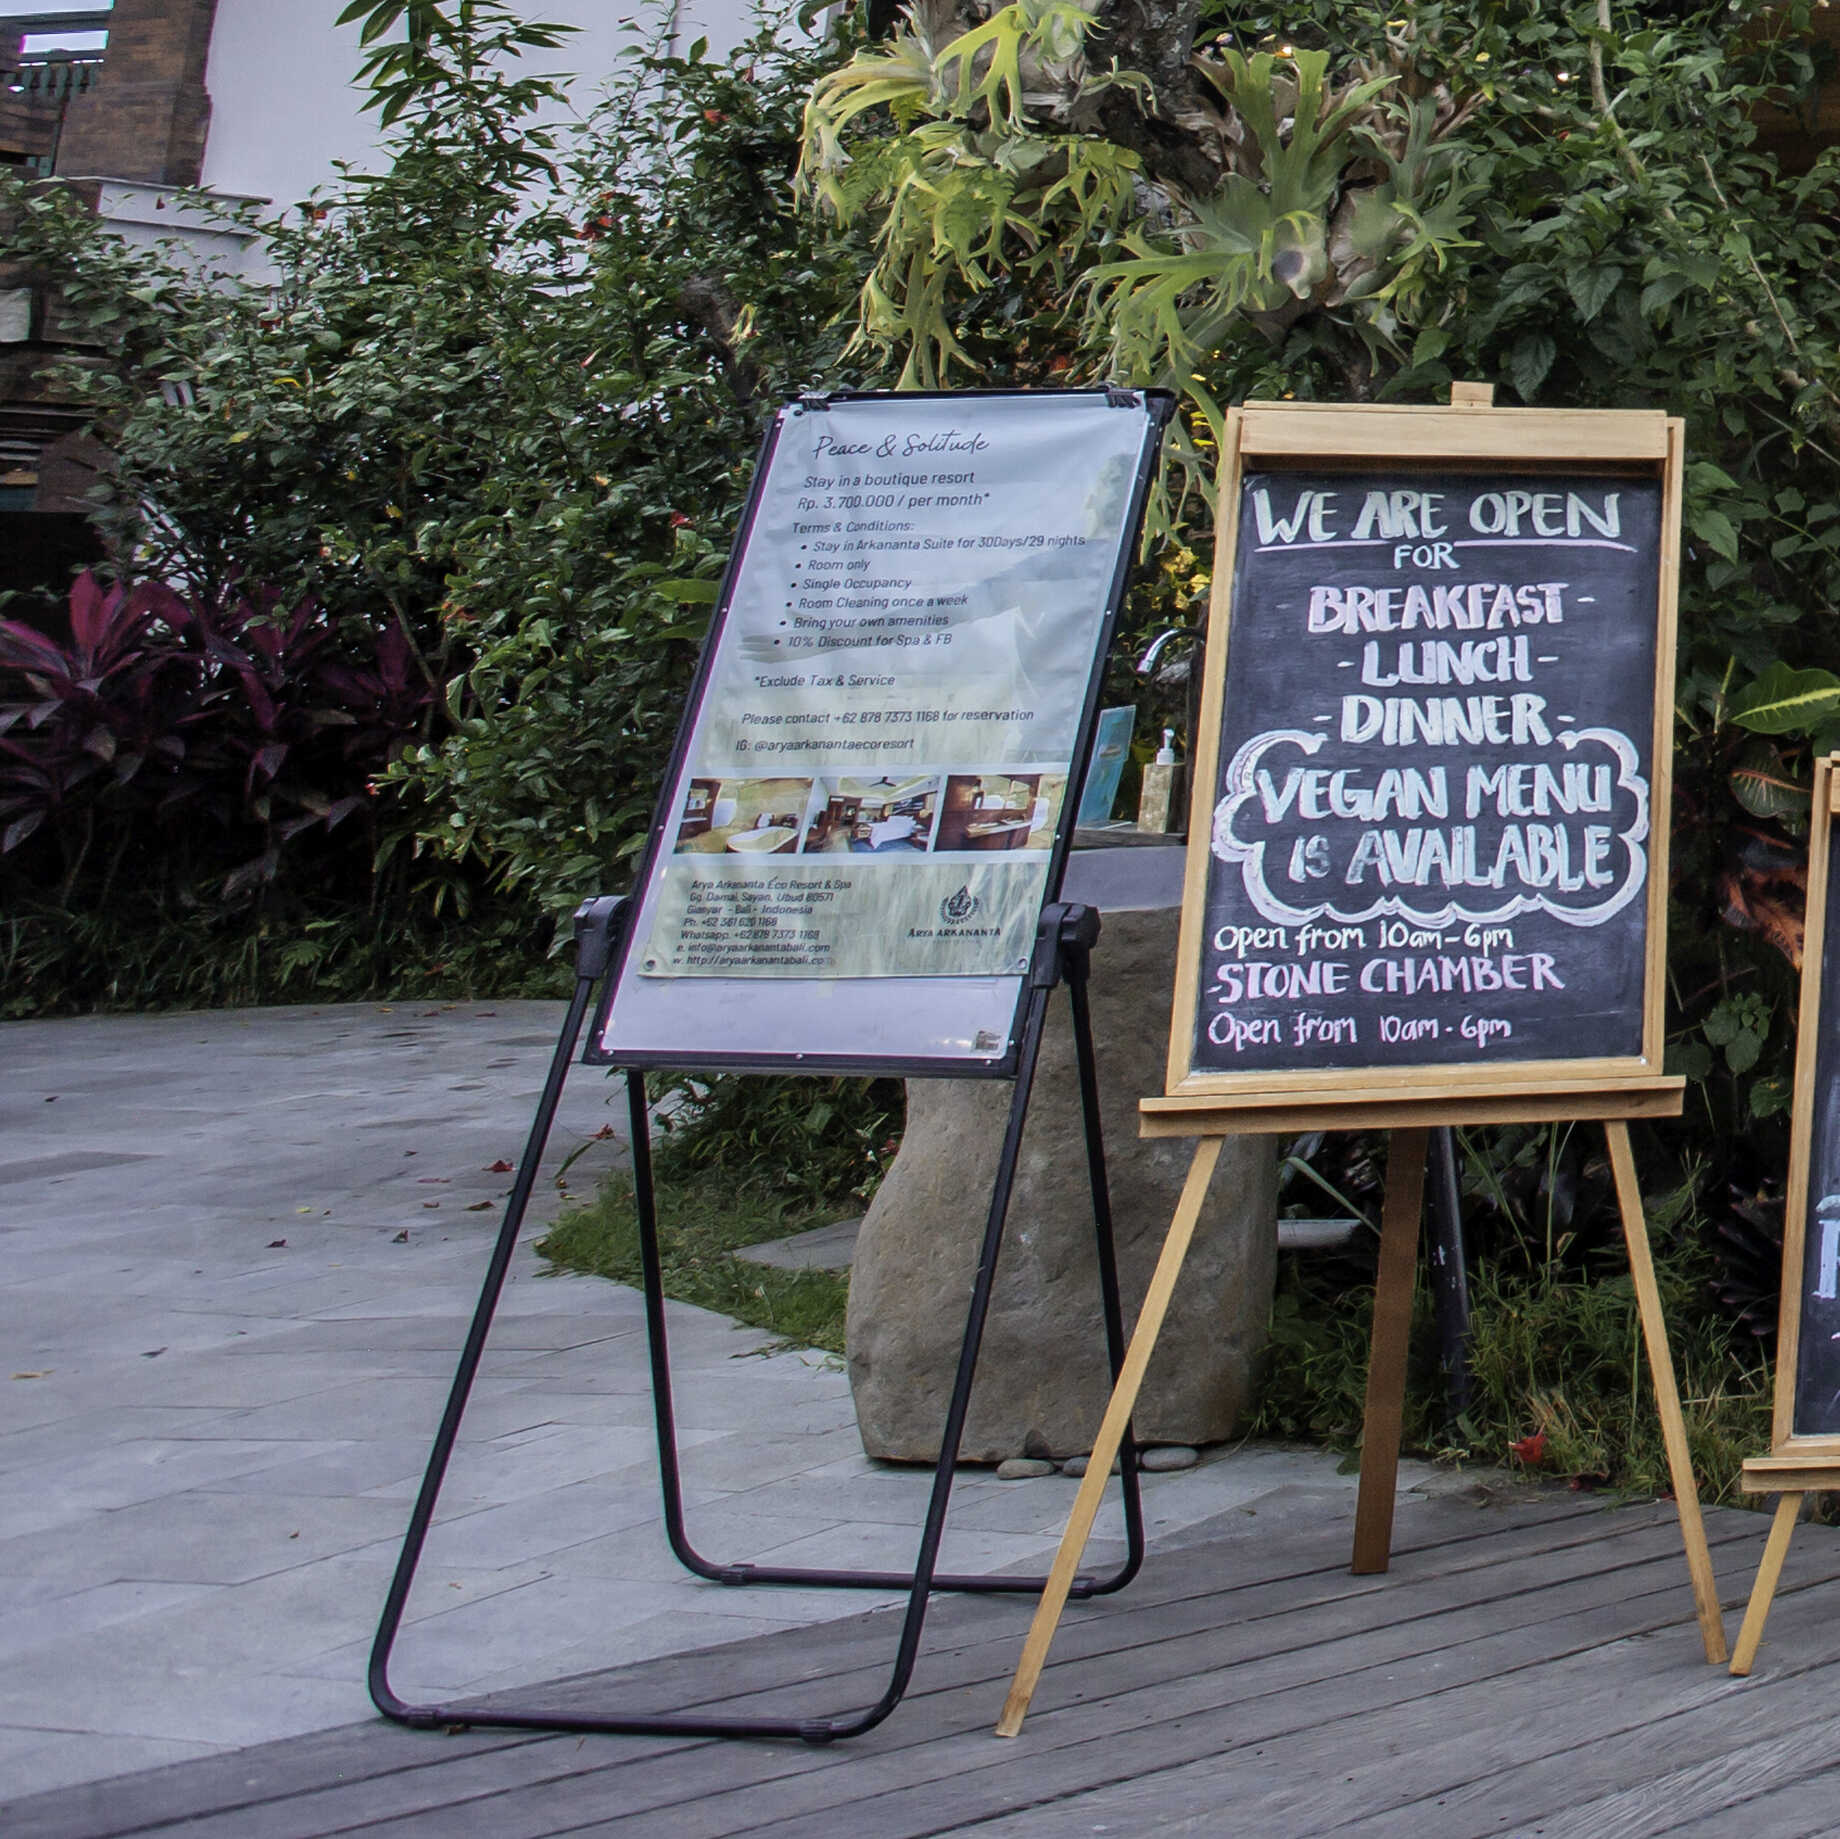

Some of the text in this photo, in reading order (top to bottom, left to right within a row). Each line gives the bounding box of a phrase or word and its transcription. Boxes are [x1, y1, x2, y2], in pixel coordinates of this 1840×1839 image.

[813, 429, 990, 459] Peace & Solitude
[804, 471, 975, 490] Stay in a boutique resort
[797, 496, 819, 512] Rp.
[823, 494, 894, 510] 3.700.000
[897, 495, 905, 508] /
[908, 496, 933, 510] per
[1252, 489, 1620, 545] WE ARE OPEN
[792, 520, 916, 535] Terms & Conditions:
[813, 541, 839, 554] Stay
[843, 540, 854, 552] in
[856, 538, 921, 551] Arkananta
[923, 538, 954, 550] Suite
[957, 537, 975, 549] for
[1047, 534, 1086, 548] nights
[1393, 543, 1460, 569] FOR
[808, 559, 871, 573] Room only
[802, 578, 912, 592] Single Occupancy
[798, 594, 968, 610] Room Cleaning once a week
[1308, 582, 1569, 634] BREAKFAST
[794, 614, 949, 631] Bring your own amenities
[787, 633, 952, 648] 10% Discount for Spa & FB
[1361, 635, 1533, 687] LUNCH
[810, 674, 833, 687] Tax
[835, 674, 845, 686] &
[848, 674, 896, 686] Service
[741, 709, 1034, 725] Please contact +62 878 7373 1168 for reservation
[1341, 693, 1556, 746] DINNER
[735, 738, 914, 754] IG: @aryaarkanantaecoresort
[1254, 764, 1612, 823] VEGAN MENU
[1288, 824, 1613, 892] IS AVAILABLE
[789, 880, 822, 889] Resort
[937, 927, 1001, 937] ARKANANTA
[1213, 925, 1289, 958] Open
[1294, 925, 1366, 956] from
[1360, 952, 1565, 995] CHAMBER
[1208, 1012, 1281, 1052] Open
[1294, 1012, 1357, 1045] from
